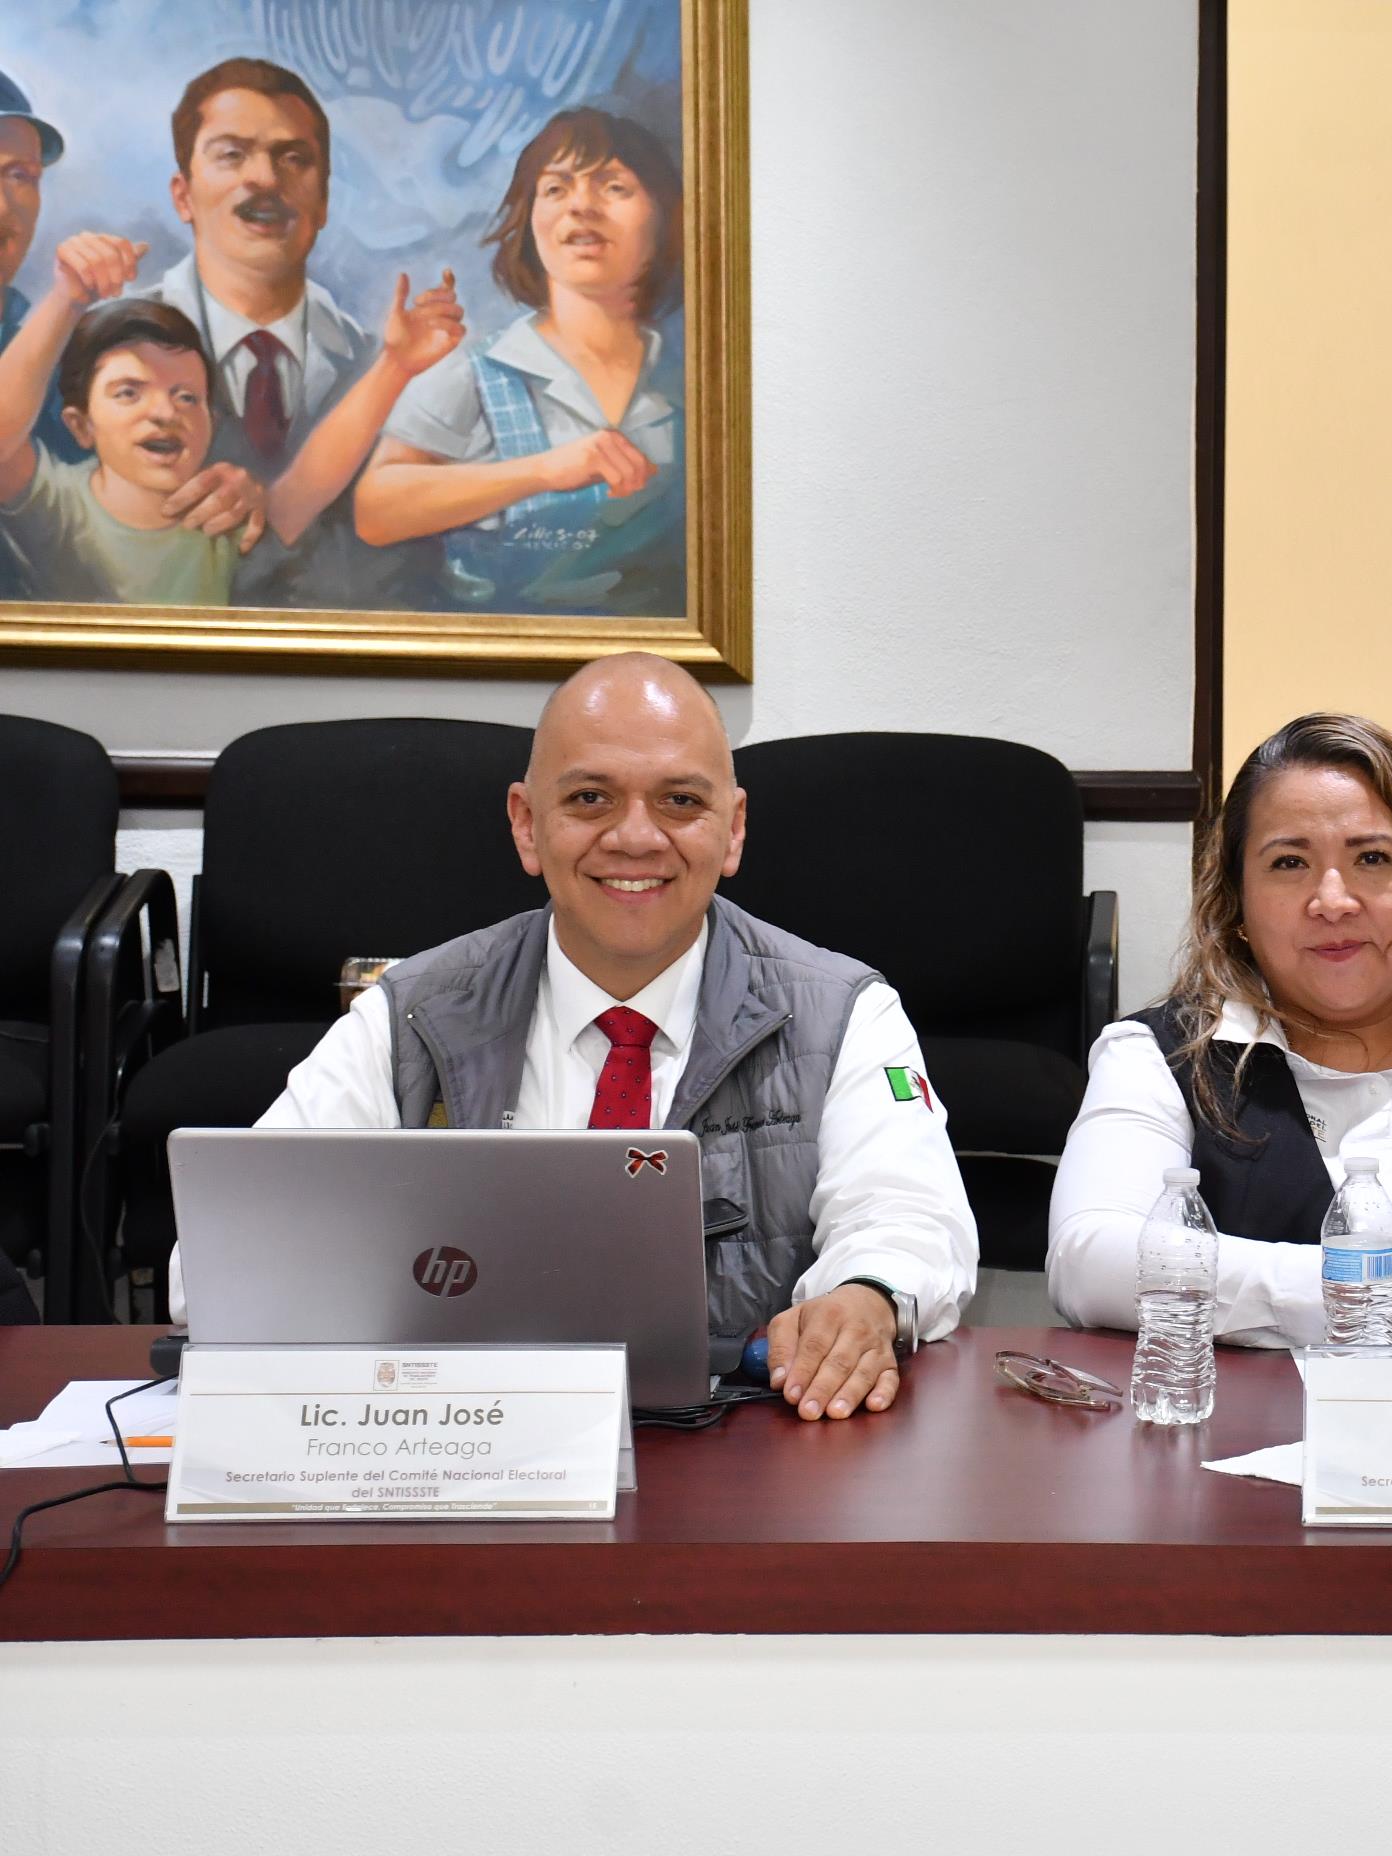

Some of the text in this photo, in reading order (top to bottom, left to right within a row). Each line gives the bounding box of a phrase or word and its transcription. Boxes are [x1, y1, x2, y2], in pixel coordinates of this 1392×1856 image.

[421, 1247, 471, 1298] hp
[301, 1400, 504, 1427] Lic. Juan José
[307, 1437, 492, 1460] Franco Arteaga
[225, 1469, 567, 1484] Secretario Suplente del Comité Nacional Electoral
[352, 1486, 440, 1498] del SNTISSSTE
